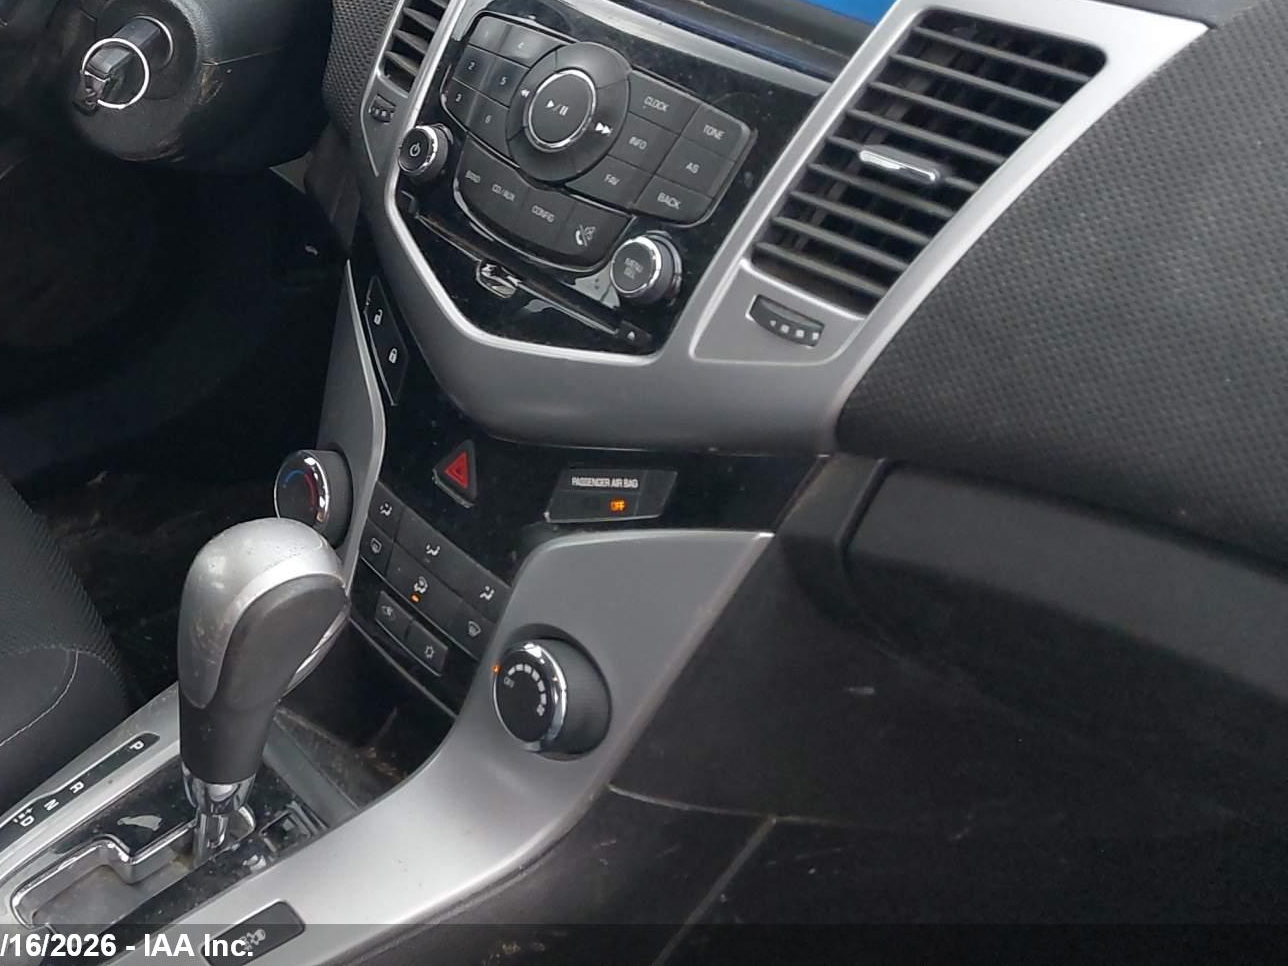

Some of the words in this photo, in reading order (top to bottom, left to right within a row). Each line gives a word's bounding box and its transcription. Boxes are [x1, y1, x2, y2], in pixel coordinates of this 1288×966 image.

[468, 61, 476, 70] 2
[501, 76, 508, 85] 5
[643, 96, 669, 112] CLOCK
[703, 124, 725, 141] TONE
[604, 173, 620, 186] FAV
[657, 192, 681, 210] BACK
[571, 477, 610, 488] PASSENGER
[611, 478, 622, 488] AIR
[623, 479, 639, 489] BAG
[610, 499, 625, 512] OFF
[129, 741, 144, 750] P
[69, 781, 84, 793] R
[44, 799, 59, 811] N
[20, 817, 34, 827] D
